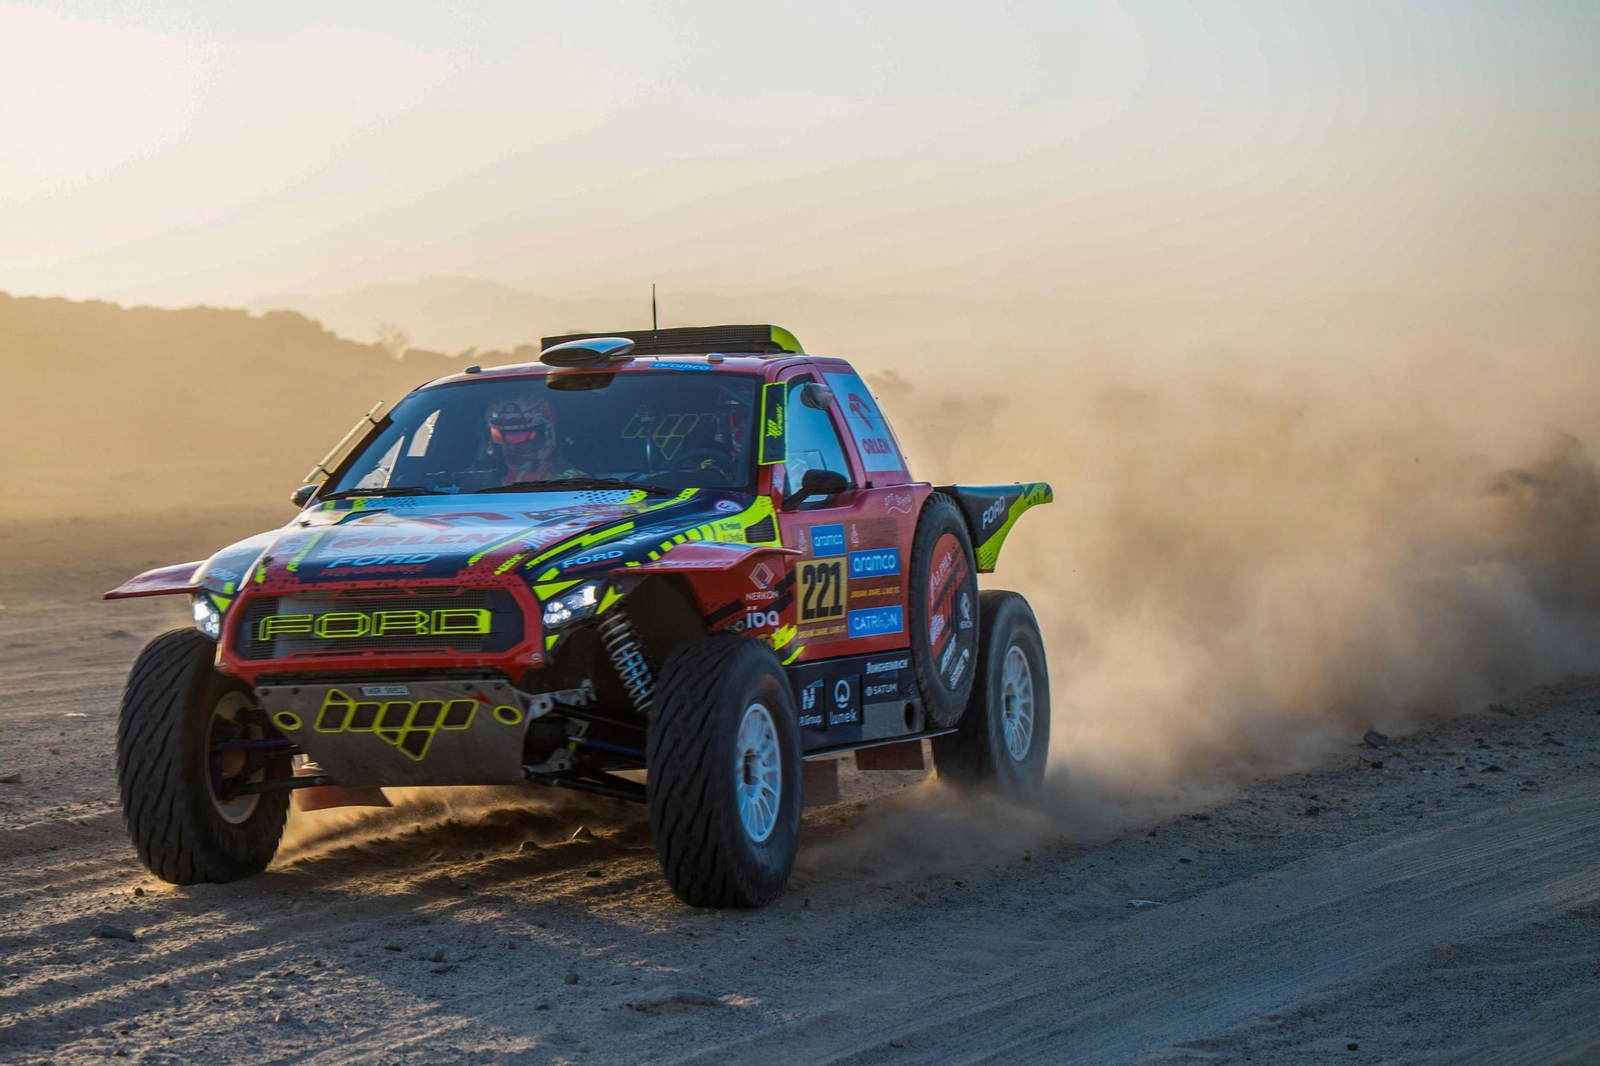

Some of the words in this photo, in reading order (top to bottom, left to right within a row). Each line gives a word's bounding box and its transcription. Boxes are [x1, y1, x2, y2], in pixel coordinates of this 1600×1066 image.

[653, 361, 711, 371] aramco
[861, 438, 892, 455] ORLEN
[982, 495, 1006, 530] FORD
[330, 533, 500, 549] ORLEN
[813, 534, 843, 547] aramco
[326, 553, 441, 568] FORD
[561, 550, 625, 569] FORD
[852, 554, 896, 573] aramco
[802, 561, 843, 621] 221
[258, 608, 493, 641] FORD
